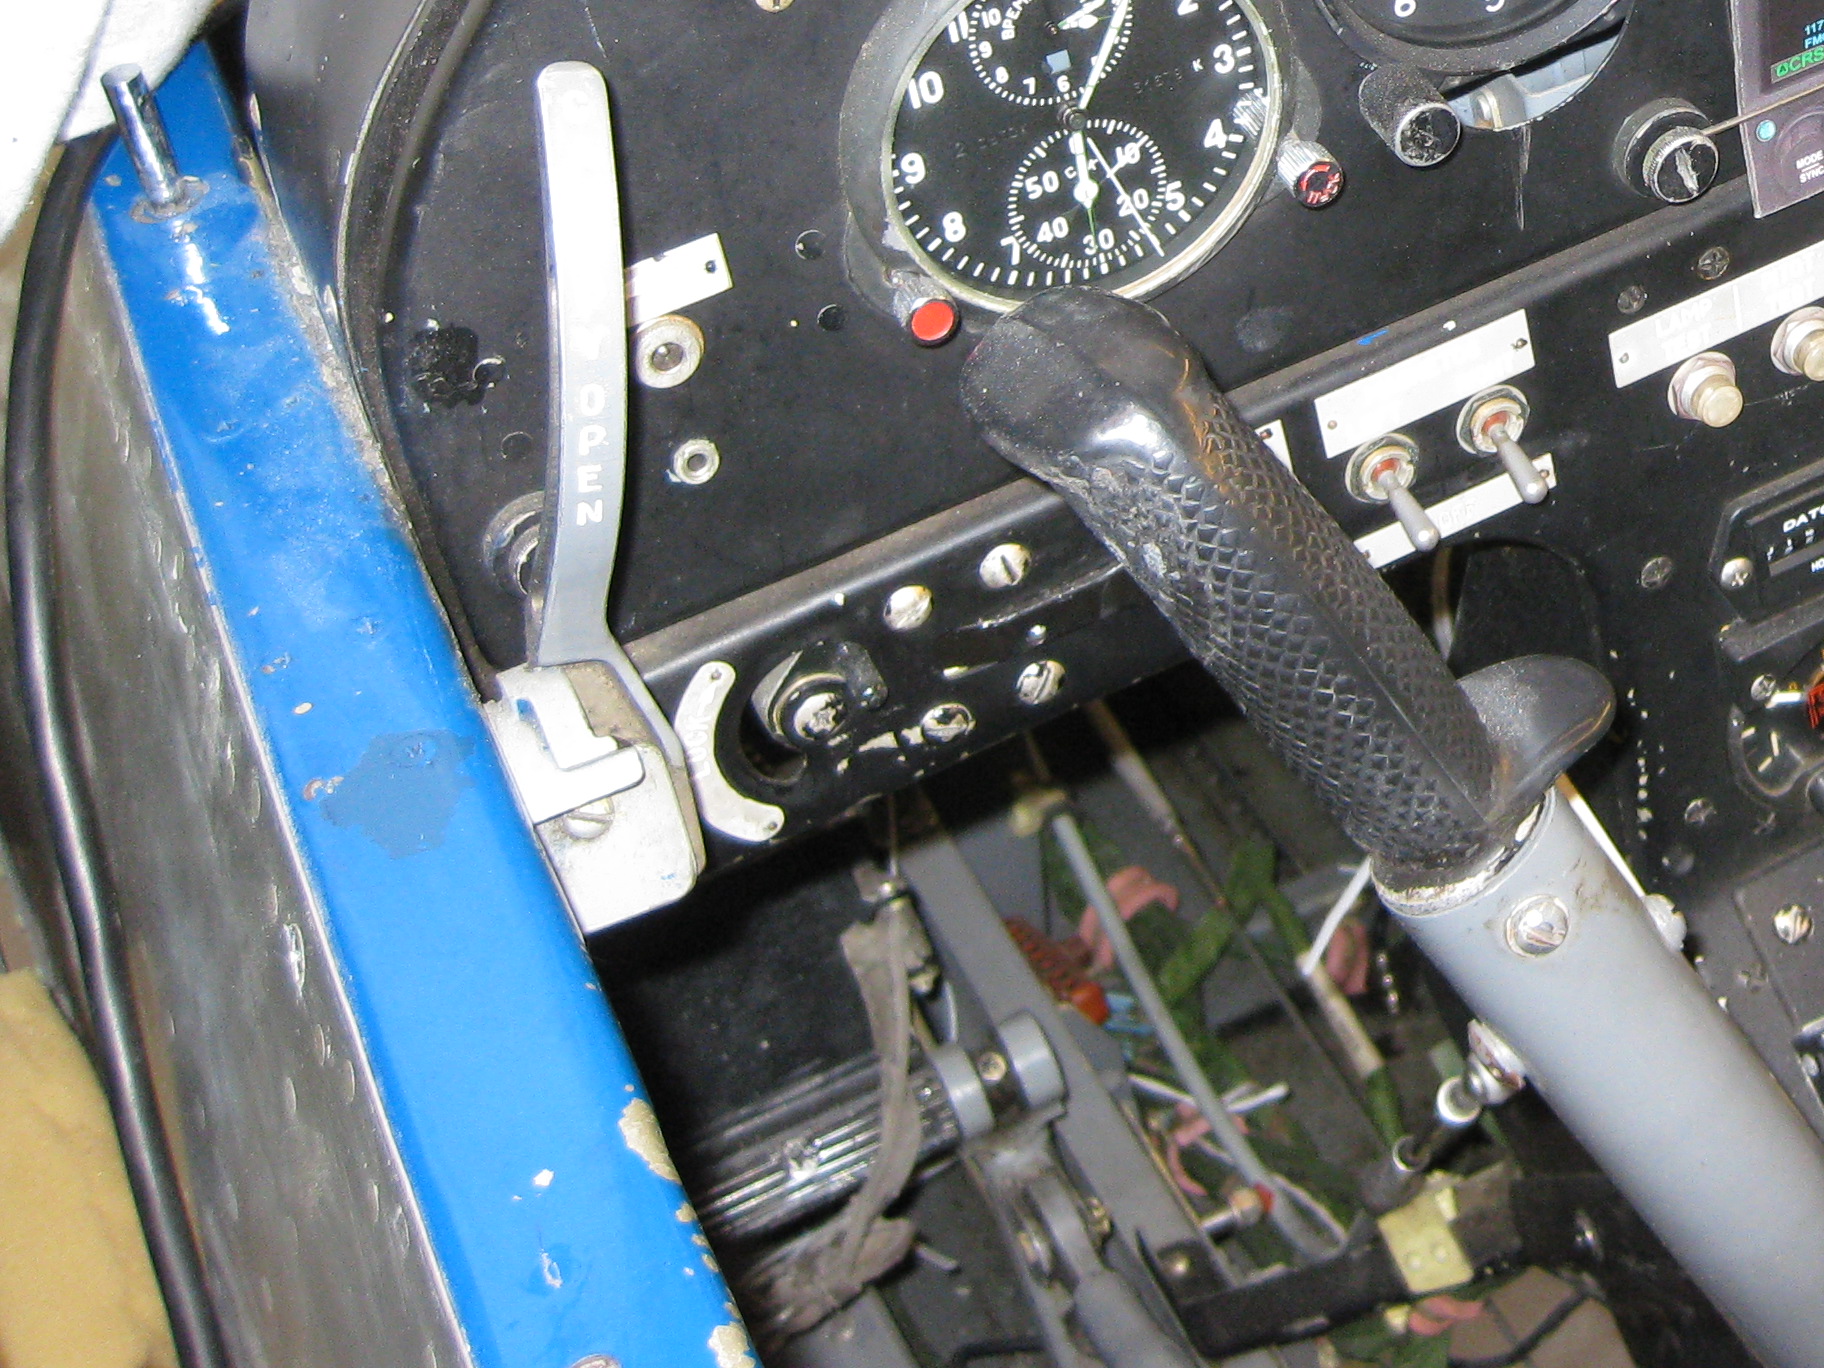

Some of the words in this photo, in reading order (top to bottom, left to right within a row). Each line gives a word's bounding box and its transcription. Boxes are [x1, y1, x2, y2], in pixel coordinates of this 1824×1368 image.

[981, 8, 1001, 28] 10
[979, 41, 992, 58] 9
[1213, 44, 1236, 74] 3
[906, 71, 943, 109] 10
[1023, 77, 1036, 94] 7
[1057, 75, 1070, 92] 6
[1204, 119, 1227, 148] 4
[900, 153, 925, 184] 9
[1796, 150, 1824, 170] MODE
[1799, 164, 1824, 183] SYNC
[1025, 171, 1059, 200] 50
[1165, 181, 1184, 210] 5
[942, 212, 966, 241] 8
[1036, 217, 1069, 243] 40
[1001, 236, 1020, 265] 7
[1083, 228, 1114, 255] 30
[576, 383, 607, 525] OPEN
